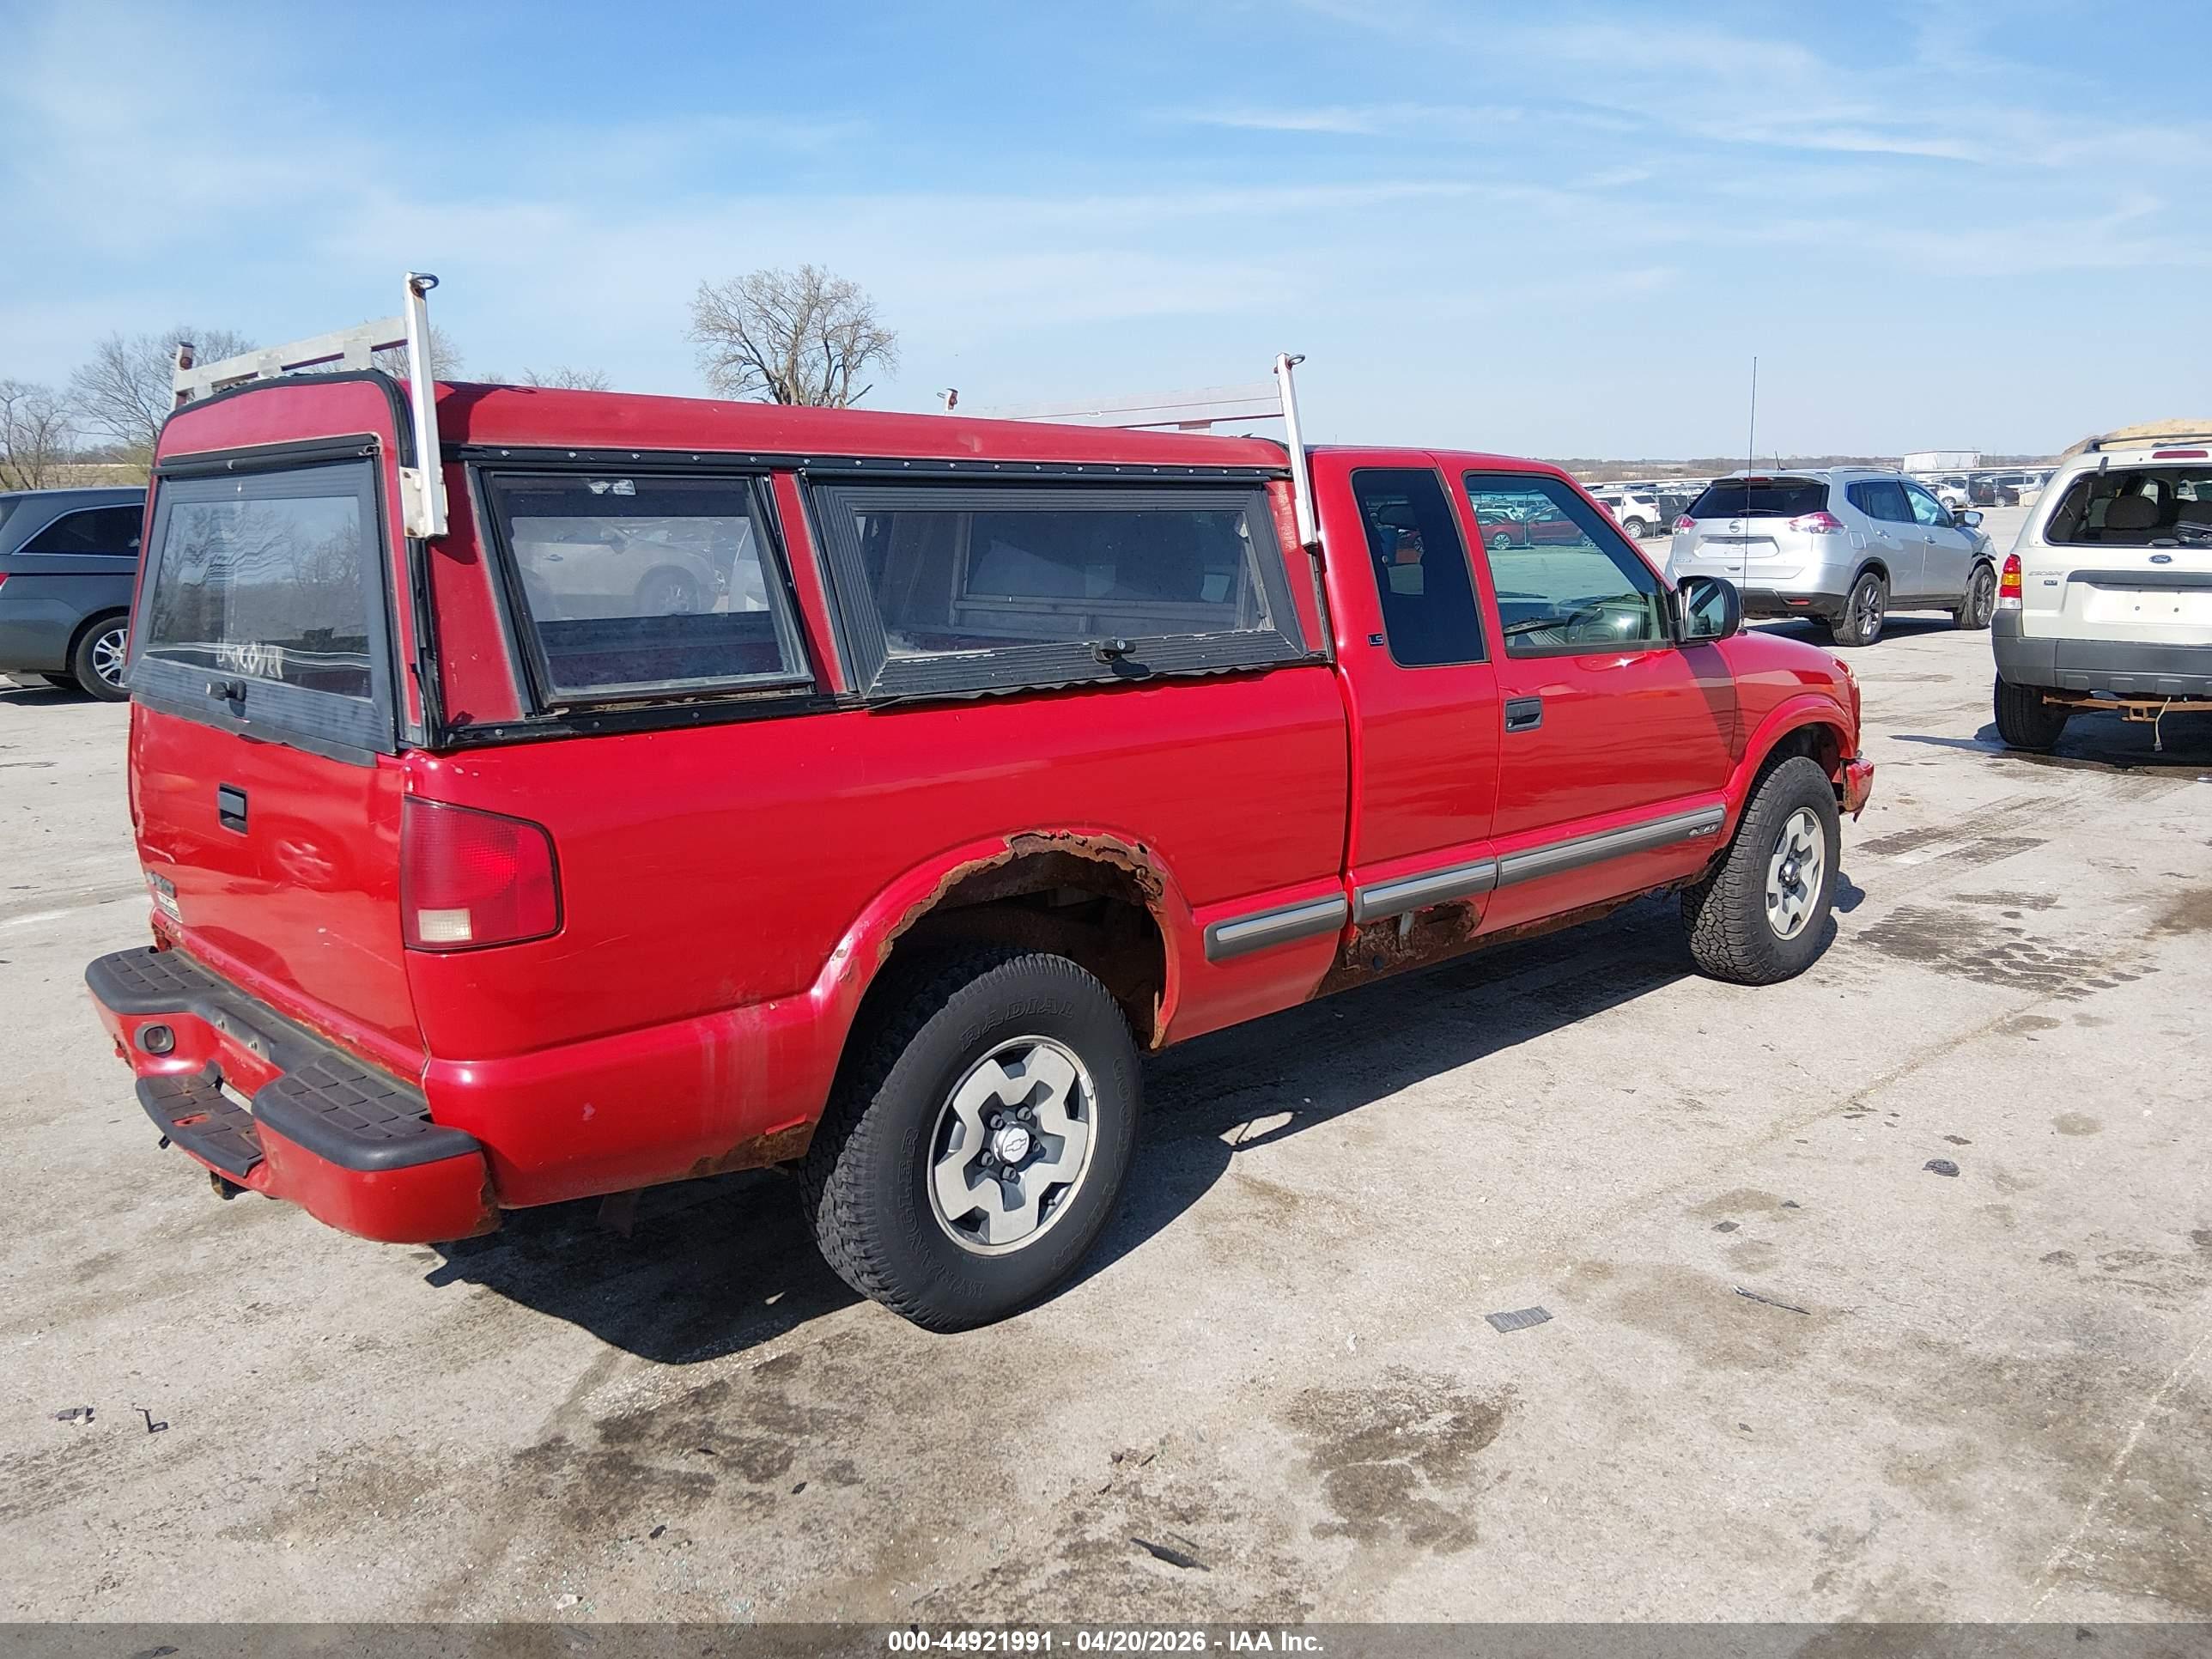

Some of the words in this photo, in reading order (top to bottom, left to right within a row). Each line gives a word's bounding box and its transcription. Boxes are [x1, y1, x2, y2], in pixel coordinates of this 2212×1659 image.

[2150, 555, 2171, 563] Ford
[1369, 635, 1384, 646] LS
[959, 996, 1074, 1052] RADIAL
[897, 1127, 986, 1299] WRANGLER
